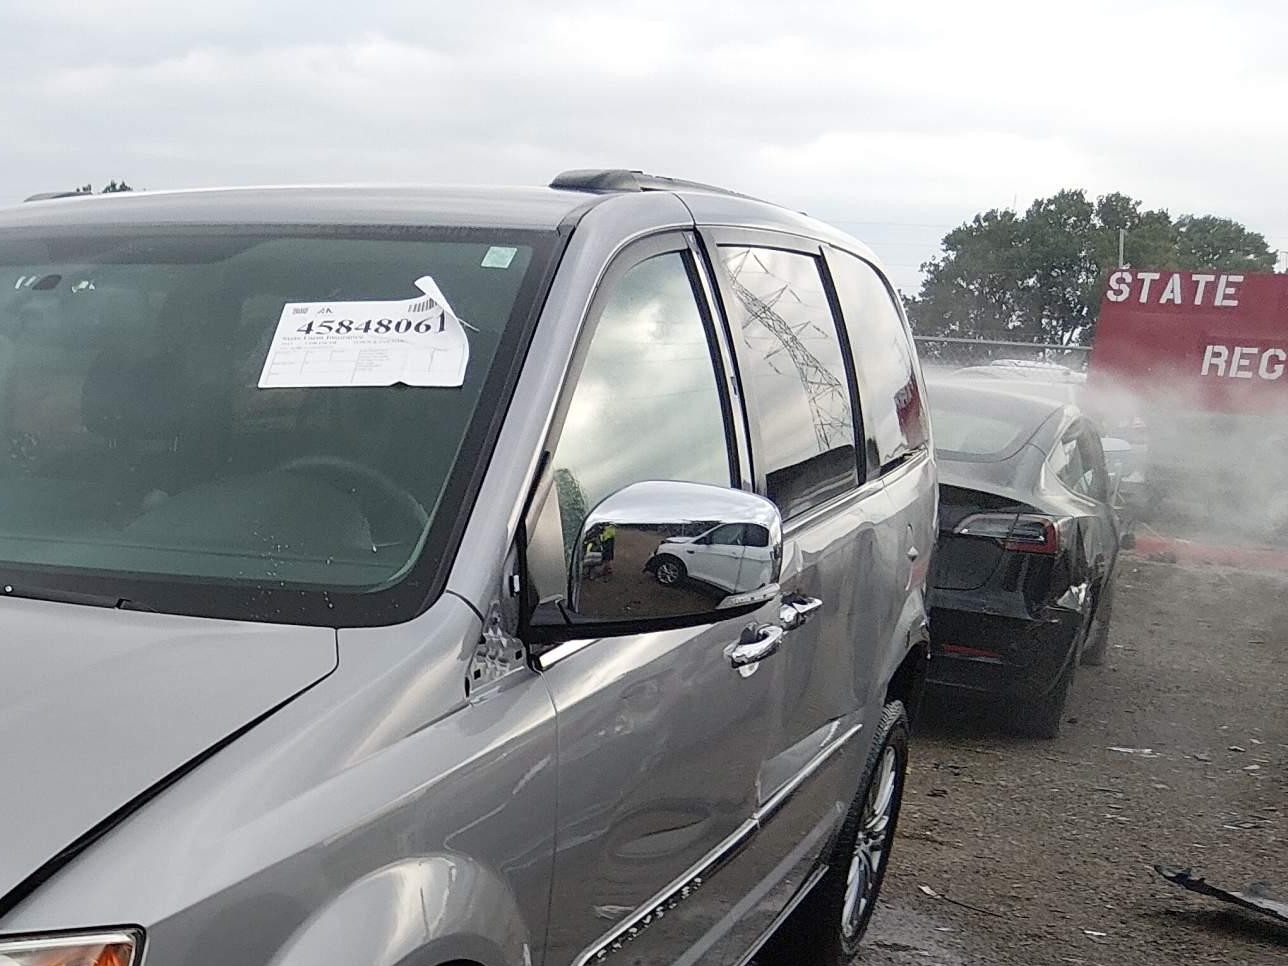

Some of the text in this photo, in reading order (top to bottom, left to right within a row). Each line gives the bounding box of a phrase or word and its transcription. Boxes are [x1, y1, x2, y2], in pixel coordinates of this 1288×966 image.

[1106, 271, 1244, 307] STATE
[296, 309, 447, 335] 45848061
[1200, 345, 1287, 381] REG
